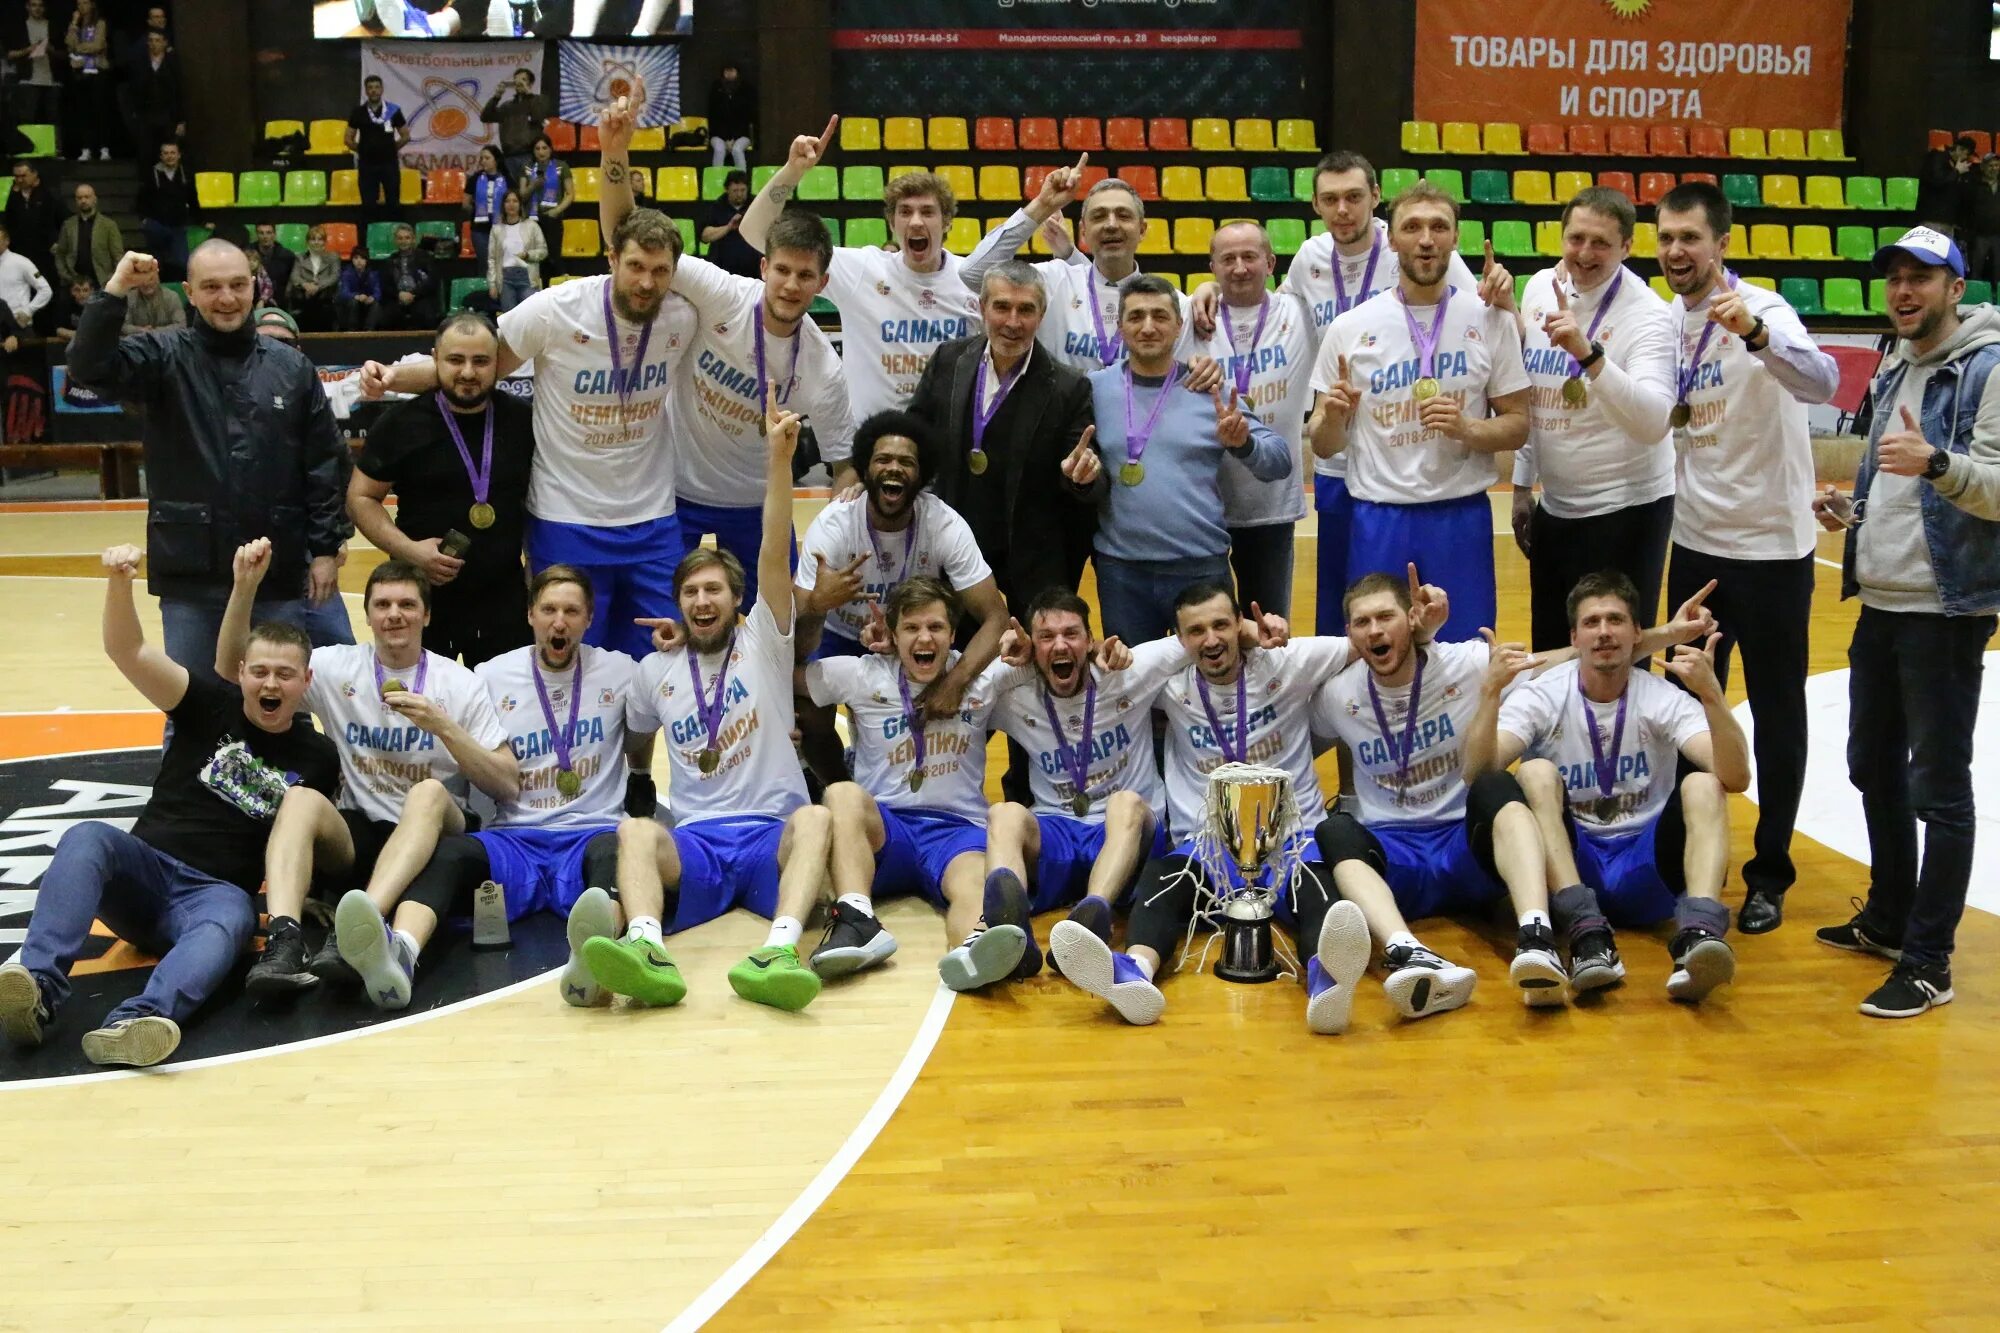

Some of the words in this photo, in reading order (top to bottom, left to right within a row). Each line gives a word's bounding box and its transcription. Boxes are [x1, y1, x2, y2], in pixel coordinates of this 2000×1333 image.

[1135, 34, 1147, 43] 28
[1160, 34, 1217, 44] bespoke.pro
[1450, 36, 1576, 69] ТОВАРЫ
[1585, 40, 1648, 76] ДЛЯ
[1657, 41, 1811, 78] ЗДОРОВЬЯ
[1560, 85, 1579, 116] И
[1589, 87, 1702, 119] СПОРТА
[881, 317, 967, 343] САМАРА
[881, 353, 929, 375] ЧЕМП
[1216, 344, 1288, 380] АМАРА
[1371, 350, 1468, 394] САМРА
[346, 722, 435, 752] САМАРА
